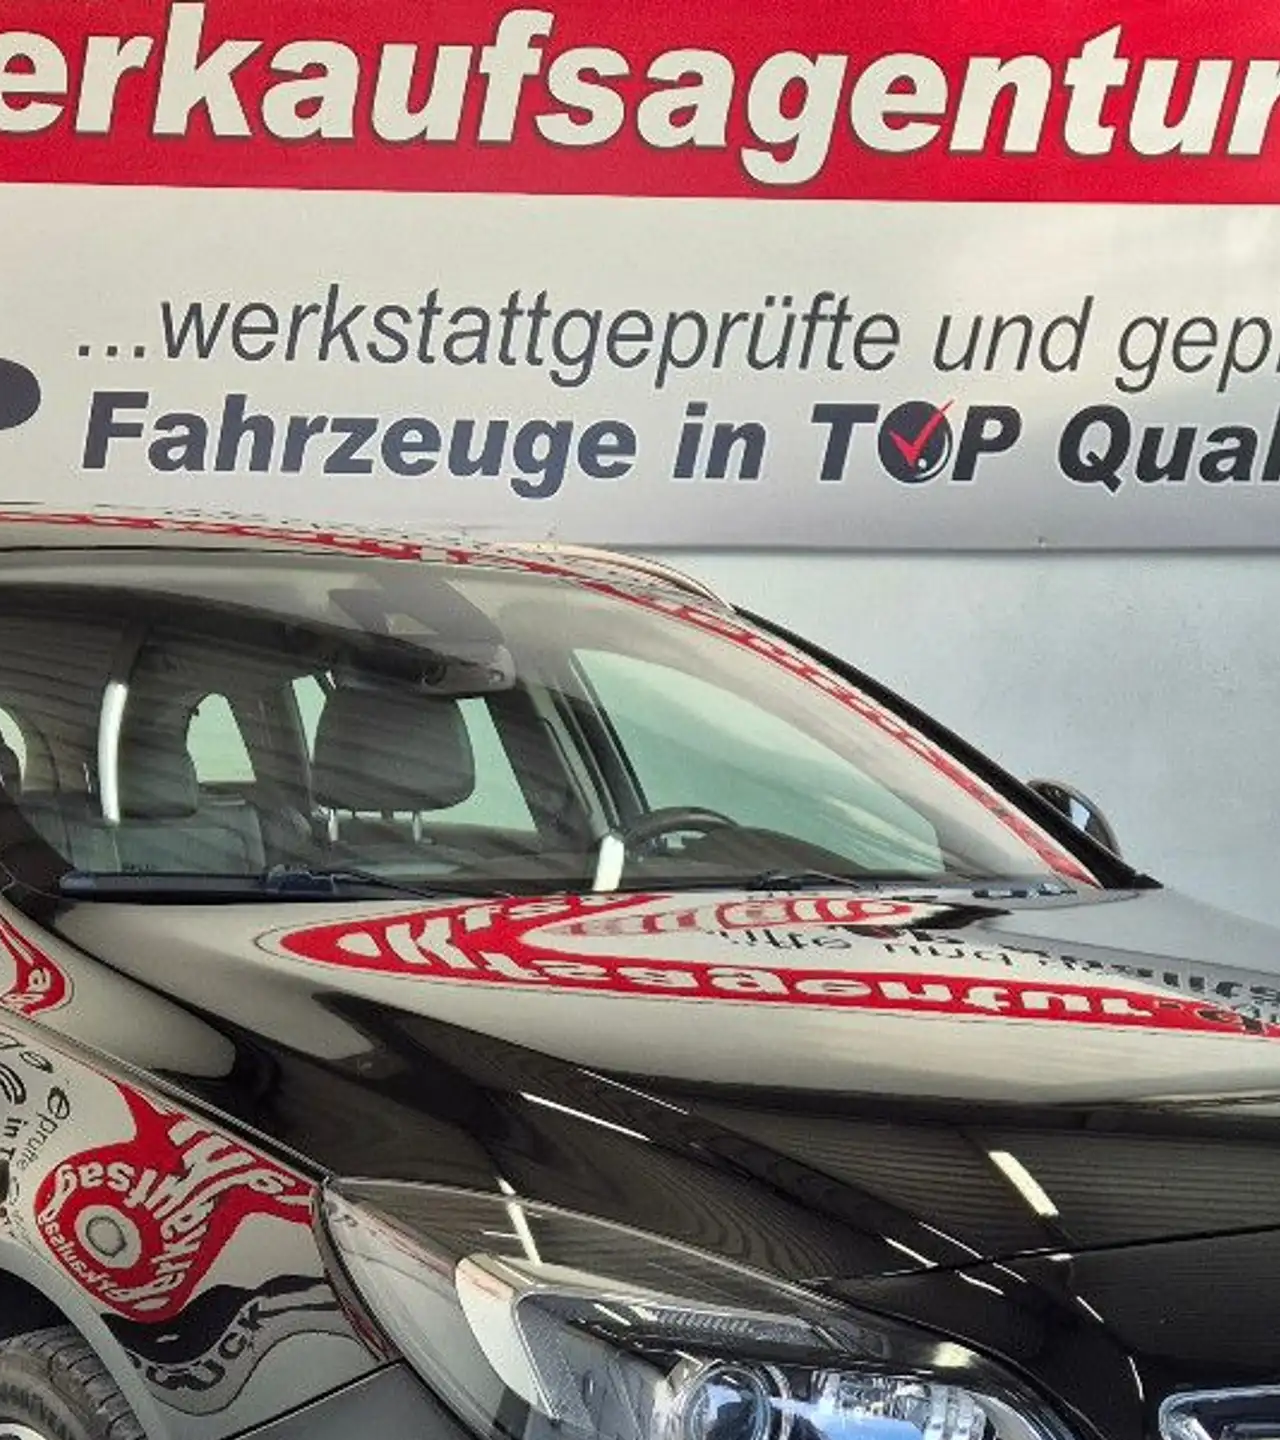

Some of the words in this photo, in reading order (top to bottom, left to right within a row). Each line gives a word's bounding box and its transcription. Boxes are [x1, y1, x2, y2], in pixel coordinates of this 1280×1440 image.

[78, 283, 900, 389] ...werkstattgeprüfte
[933, 295, 1094, 374] und
[82, 391, 638, 499] Fahrzeuge
[673, 401, 767, 481] in
[811, 399, 1023, 484] TOP
